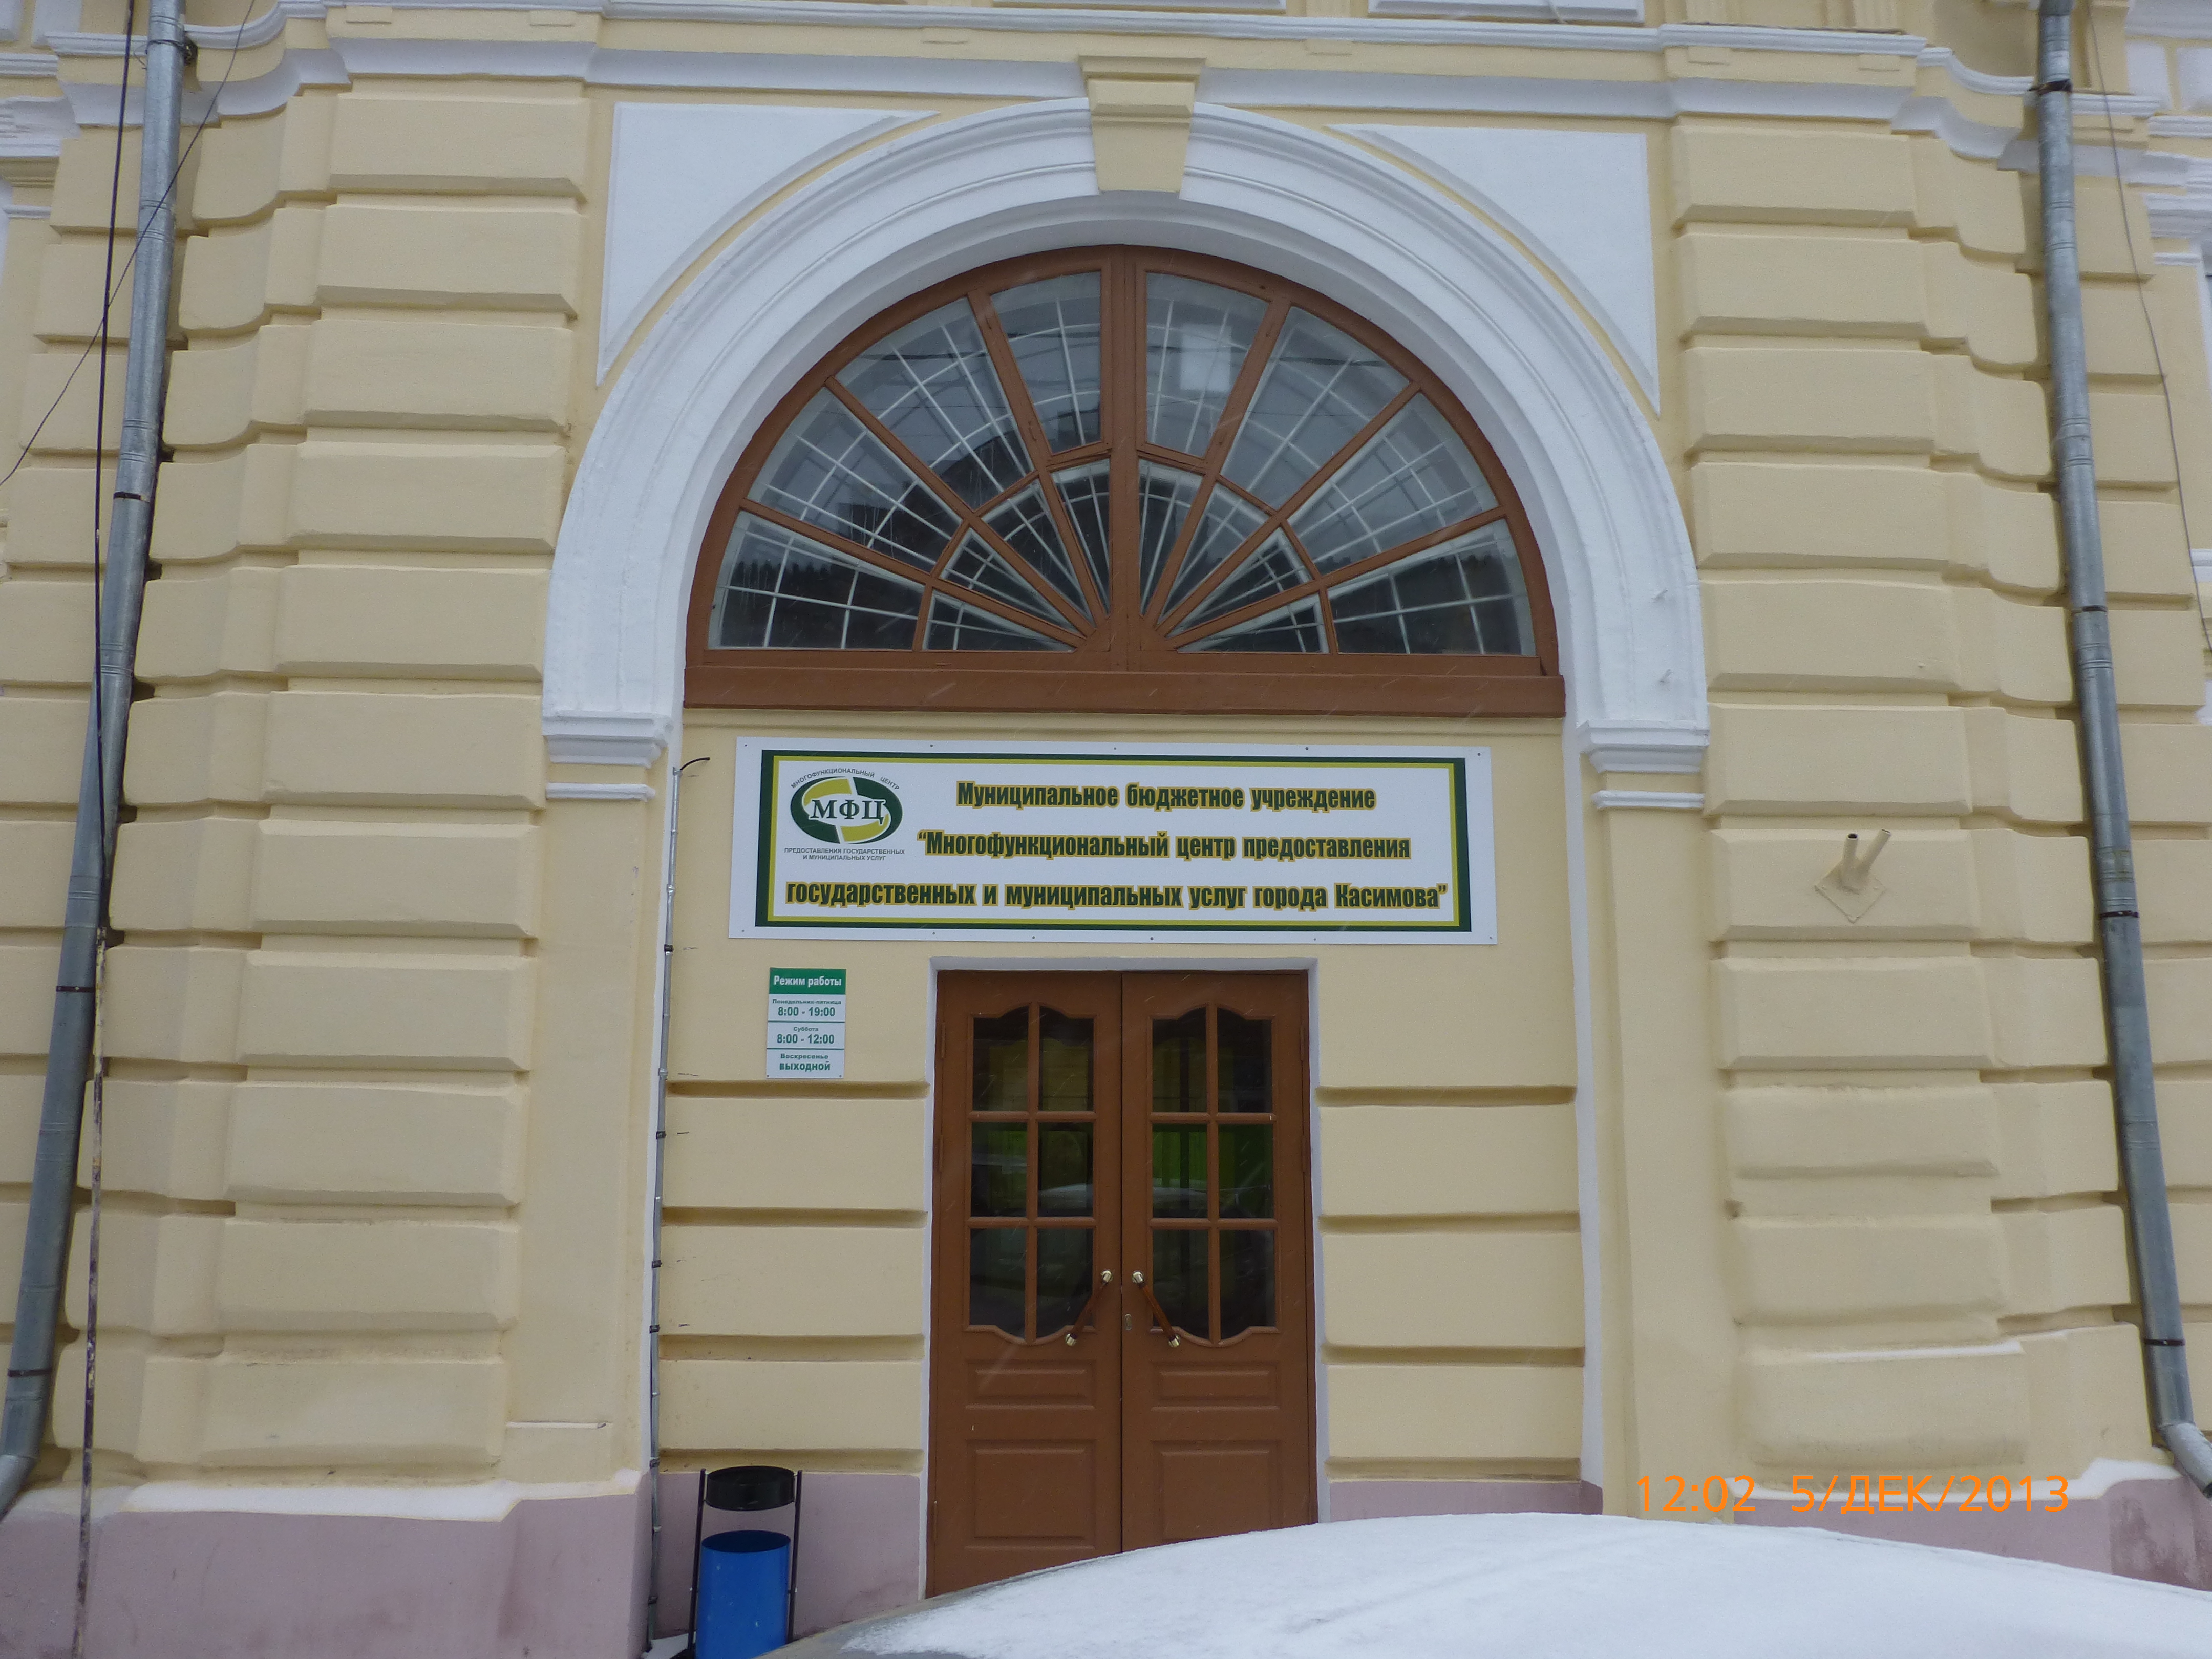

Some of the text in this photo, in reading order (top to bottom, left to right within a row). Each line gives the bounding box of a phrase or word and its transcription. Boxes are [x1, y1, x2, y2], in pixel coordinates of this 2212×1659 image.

[791, 768, 900, 790] МНОГОФУНКЦИОНАЛЬНЫЙ ЦЕНТР
[957, 781, 1376, 813] Муниципальное бюджетное учреждение
[810, 799, 886, 825] МФЦ
[1175, 836, 1236, 861] центр
[1242, 837, 1411, 862] предоставления
[785, 881, 977, 908] государственных
[983, 884, 998, 906] и
[1005, 885, 1183, 909] муниципальных
[1187, 885, 1248, 911] услуг
[1253, 885, 1328, 911] города
[774, 975, 842, 987] Режим работы
[778, 1007, 799, 1016] 8:00
[809, 1007, 835, 1016] 19:00
[777, 1034, 798, 1044] 8:00
[807, 1034, 835, 1044] 12:00
